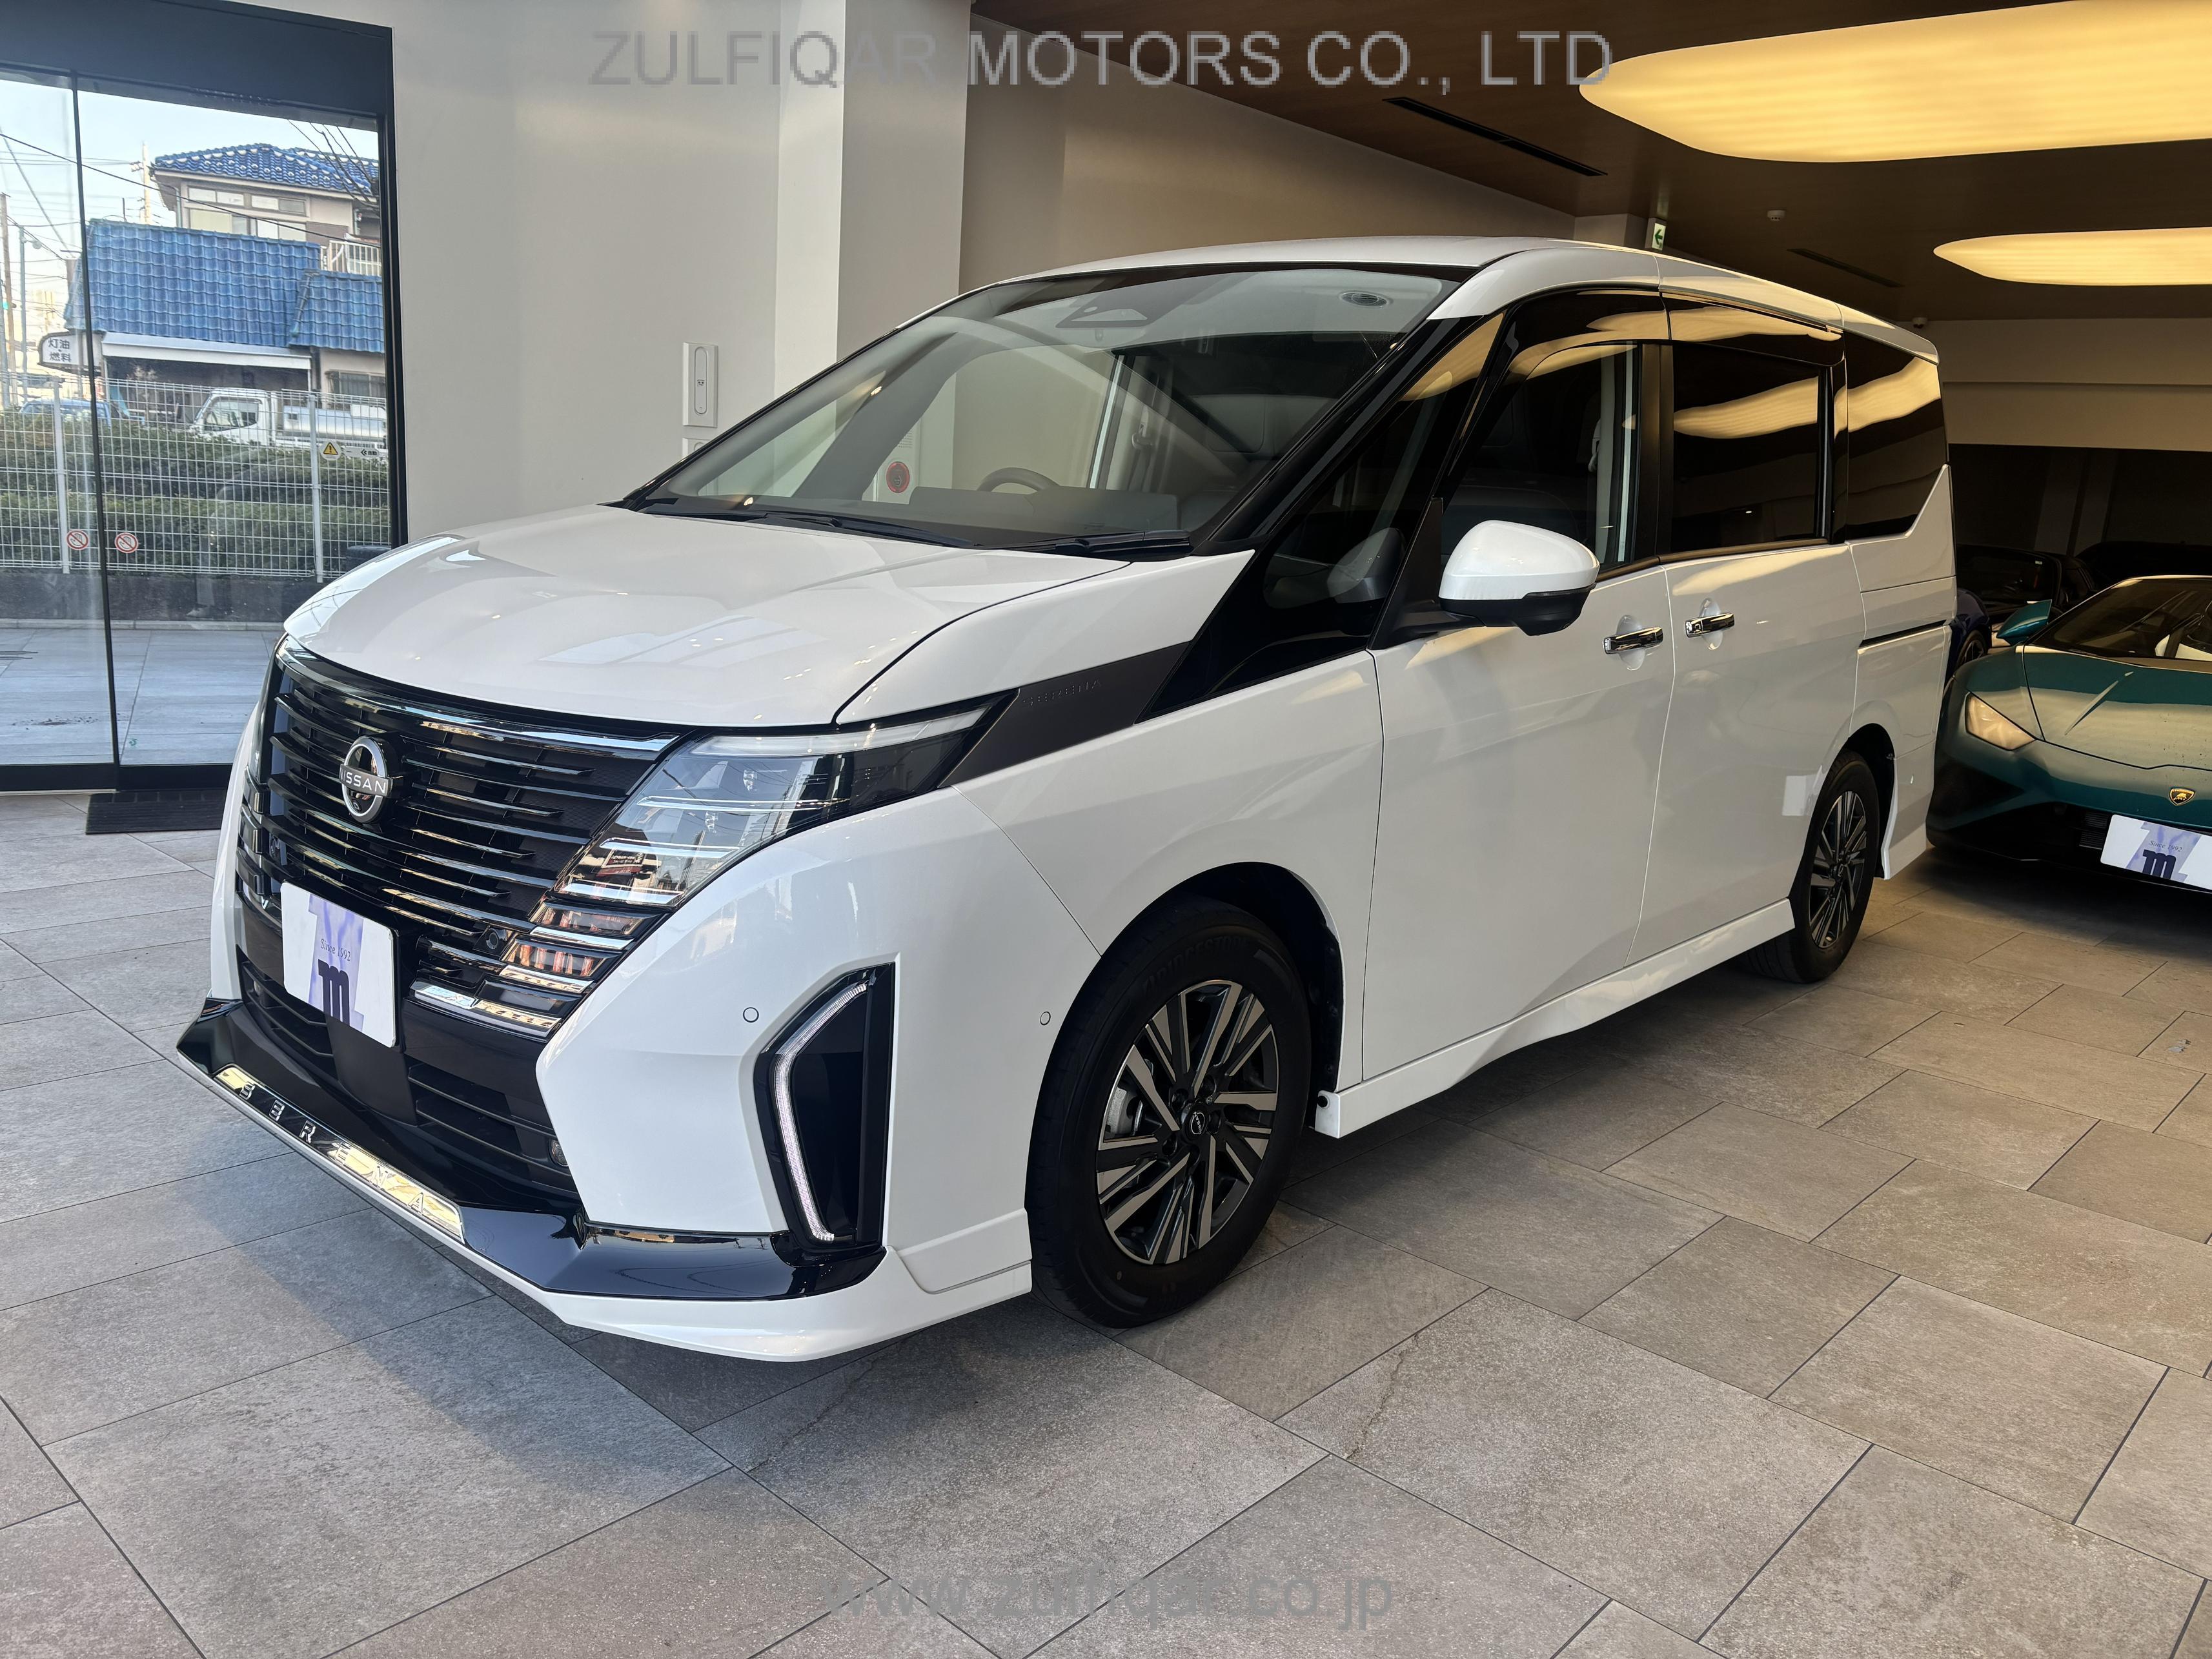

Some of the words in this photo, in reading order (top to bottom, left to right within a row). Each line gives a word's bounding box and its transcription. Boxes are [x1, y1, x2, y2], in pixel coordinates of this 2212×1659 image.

[48, 338, 70, 349] 灯油
[339, 767, 387, 794] NISSAN
[2167, 844, 2183, 853] 1992
[320, 939, 336, 955] Since
[337, 947, 351, 962] 1992
